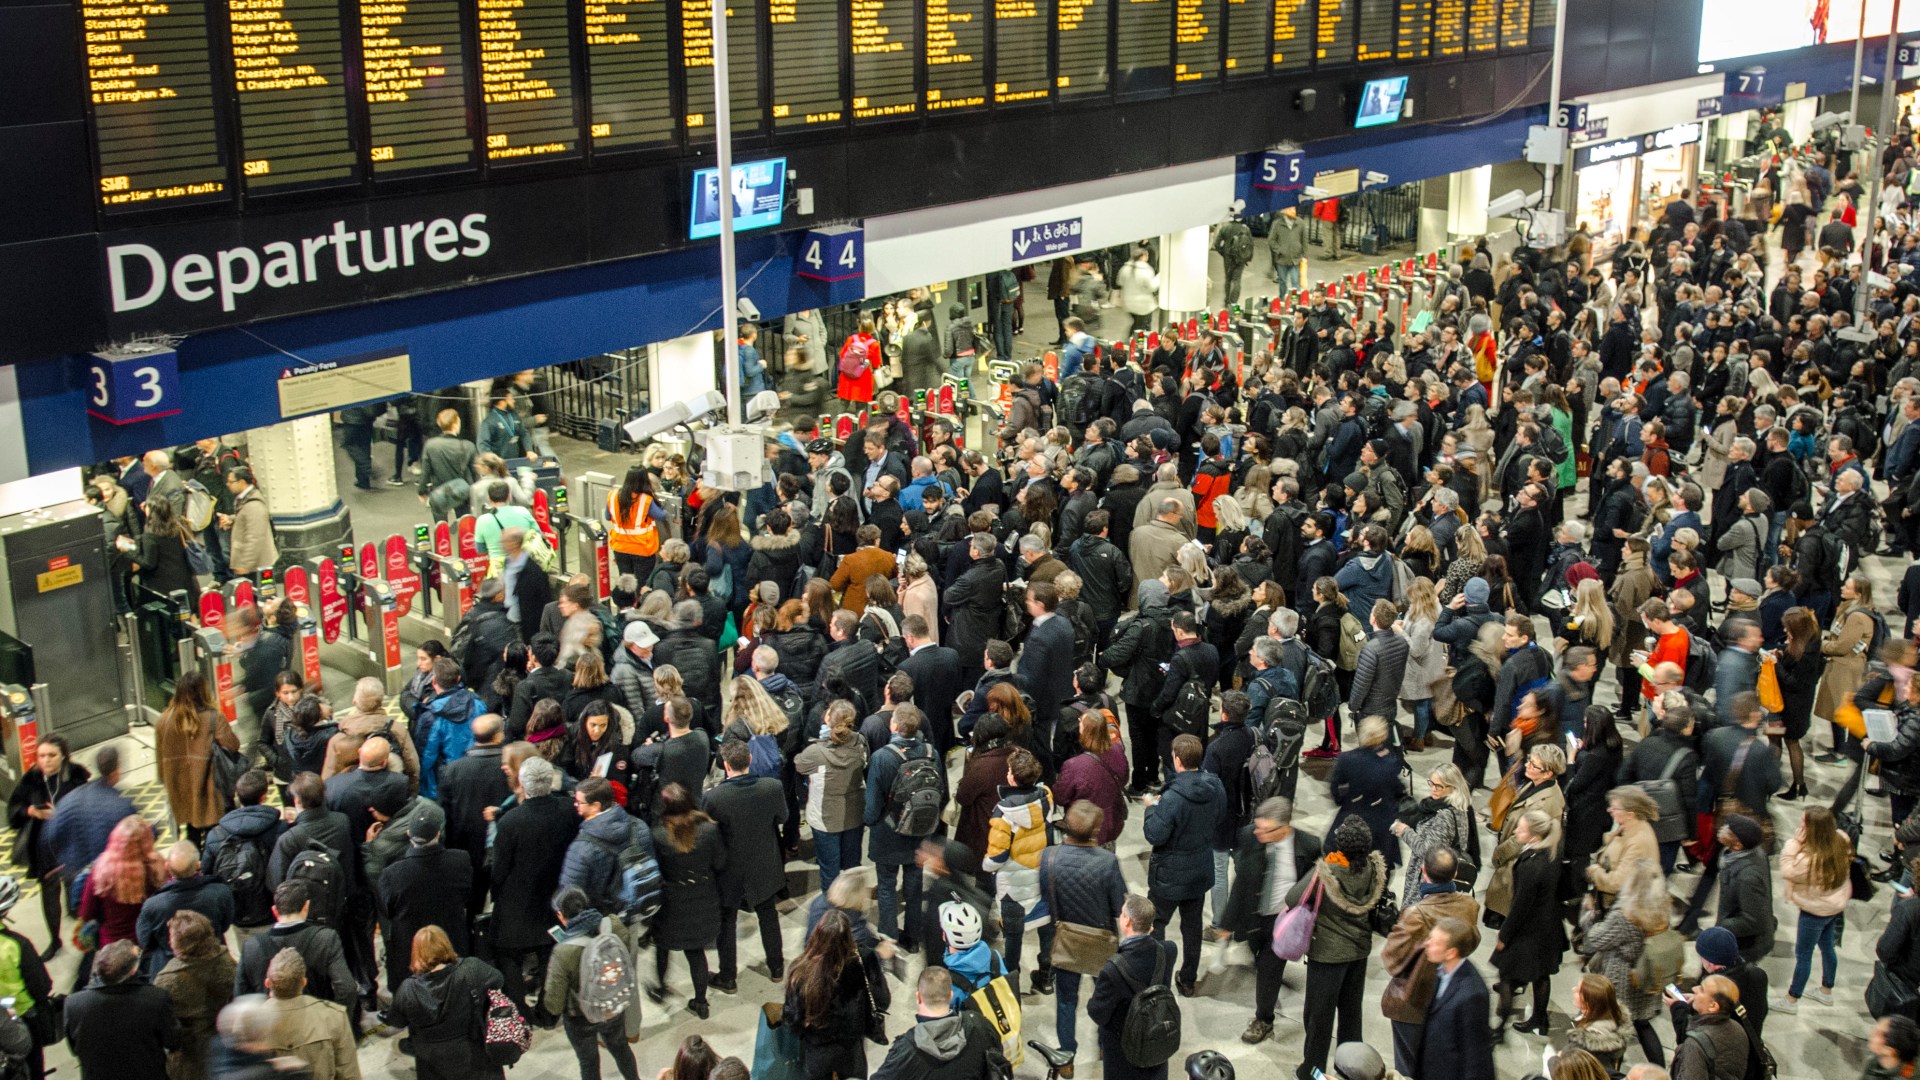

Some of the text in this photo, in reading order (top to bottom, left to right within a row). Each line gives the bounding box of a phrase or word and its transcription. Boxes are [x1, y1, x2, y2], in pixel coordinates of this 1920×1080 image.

[83, 4, 169, 18] Worcester Park
[229, 0, 285, 10] Earlsfield
[361, 4, 407, 14] Wimbledon
[585, 5, 607, 14] Fleet
[230, 11, 281, 21] Wimbledon
[479, 10, 513, 19] Andover
[586, 14, 627, 24] Winchfield
[85, 18, 147, 30] Stoneleigh
[361, 16, 402, 26] Surbiton
[231, 21, 293, 34] Raynes Park
[362, 27, 389, 37] Esher
[587, 25, 605, 34] Hook
[86, 30, 147, 42] Ewell West
[274, 33, 298, 42] Park
[480, 31, 521, 40] Salisbury
[363, 38, 400, 48] Hersham
[481, 42, 514, 51] Tisbury
[87, 45, 122, 55] Epsom
[233, 45, 299, 56] Malden Manor
[363, 46, 442, 59] Walton-on-Thames
[1898, 49, 1909, 63] 8
[89, 55, 134, 66] Ashtead
[234, 56, 280, 67] Tolworth
[482, 51, 525, 62] Gillingham
[364, 59, 410, 70] Weybridge
[90, 65, 159, 79] Leatherhead
[235, 68, 296, 79] Chessington
[365, 70, 400, 82] Byfleet
[410, 68, 427, 77] New
[428, 67, 446, 76] Haw
[91, 80, 136, 91] Bookham
[236, 82, 245, 91] &
[247, 78, 306, 89] Chessington
[366, 79, 423, 91] West Byfleet
[484, 80, 548, 92] Yeovil Junction
[995, 83, 1008, 94] SWR
[1738, 76, 1750, 93] 7
[92, 88, 178, 103] & Effingham Jn.
[492, 91, 519, 102] Yeovil
[520, 91, 536, 99] Pen
[927, 90, 941, 101] SWR
[853, 97, 868, 109] SWR
[773, 105, 790, 118] SWR
[857, 108, 875, 118] travel
[1557, 108, 1569, 127] 6
[1578, 107, 1586, 128] 6
[686, 114, 704, 127] SWR
[591, 124, 611, 138] SWR
[487, 134, 508, 149] SWR
[371, 147, 394, 162] SWR
[244, 160, 270, 176] SWR
[1263, 159, 1277, 182] 5
[1289, 159, 1300, 182] 5
[101, 176, 130, 192] SWR
[112, 191, 153, 204] earlier
[156, 186, 185, 198] train
[187, 183, 215, 195] fault
[806, 240, 823, 270] 4
[839, 240, 857, 269] 4
[107, 213, 491, 313] Departures
[294, 362, 337, 375] Penalty Fares
[91, 367, 109, 407] 3
[133, 367, 163, 408] 3
